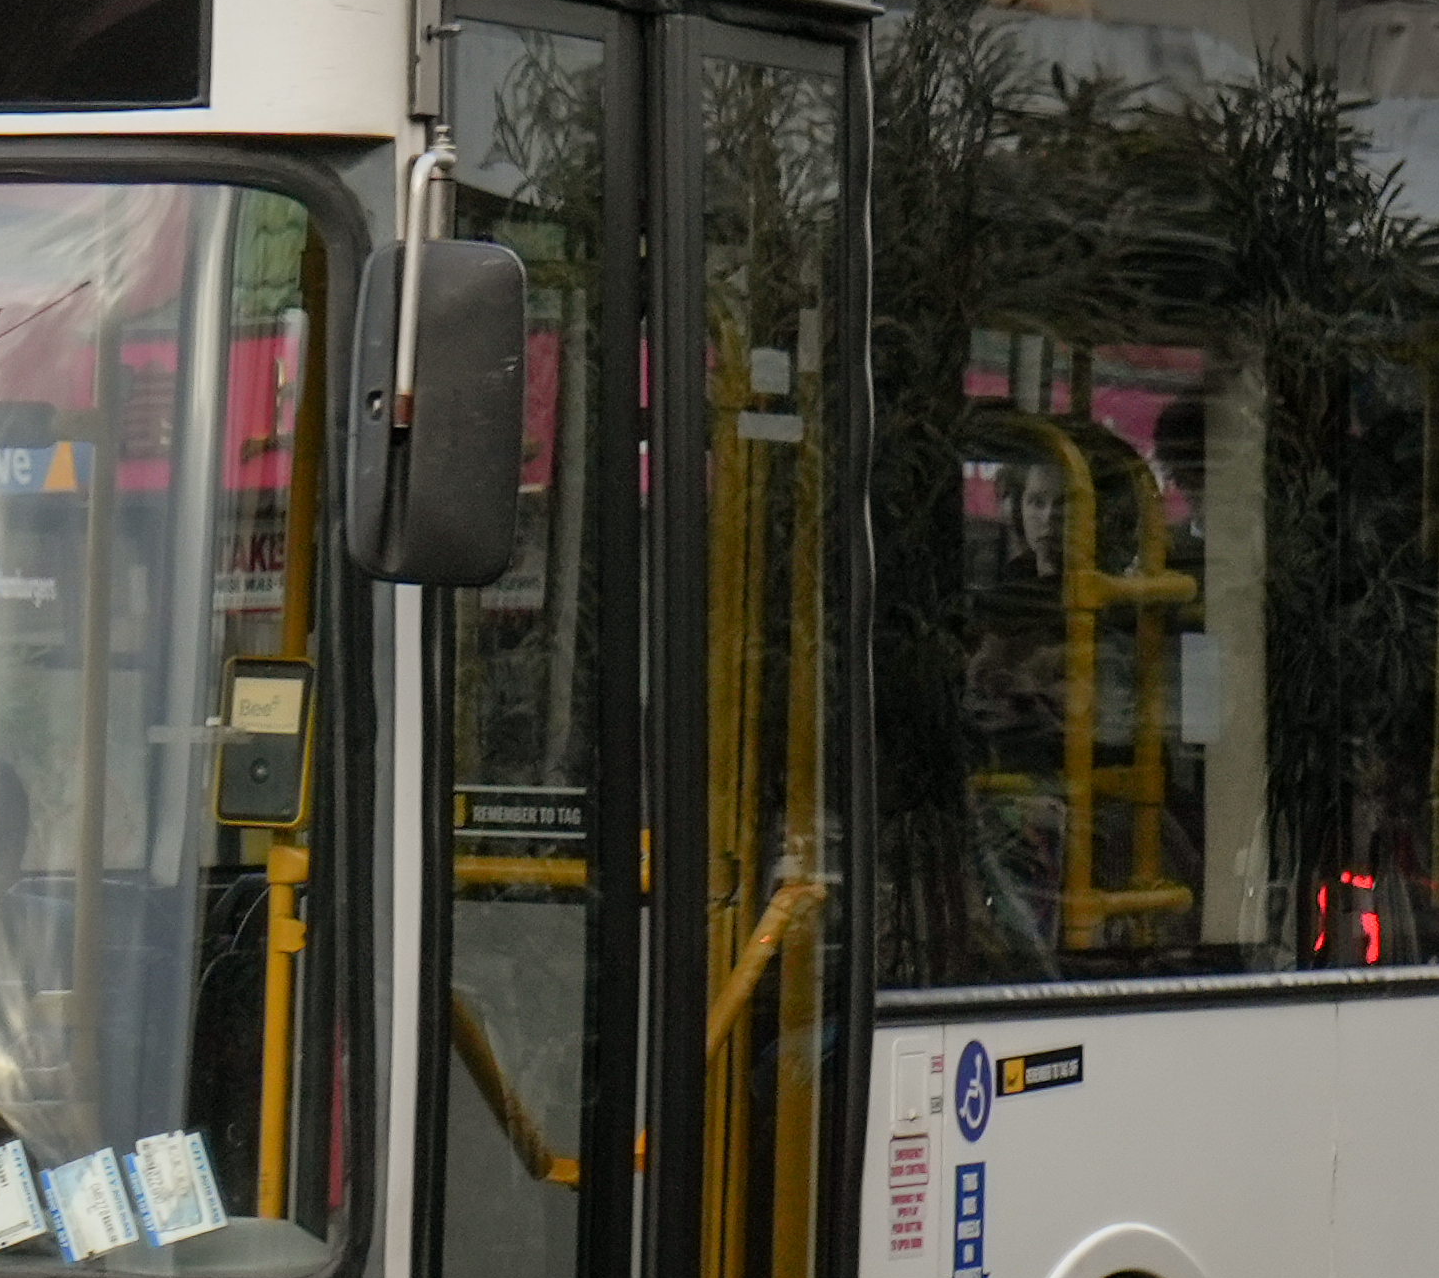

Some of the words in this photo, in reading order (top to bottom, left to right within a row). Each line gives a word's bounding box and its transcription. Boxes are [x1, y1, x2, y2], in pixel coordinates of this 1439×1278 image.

[473, 805, 538, 824] REMEMBER
[540, 806, 556, 824] TO
[558, 807, 582, 826] TAG
